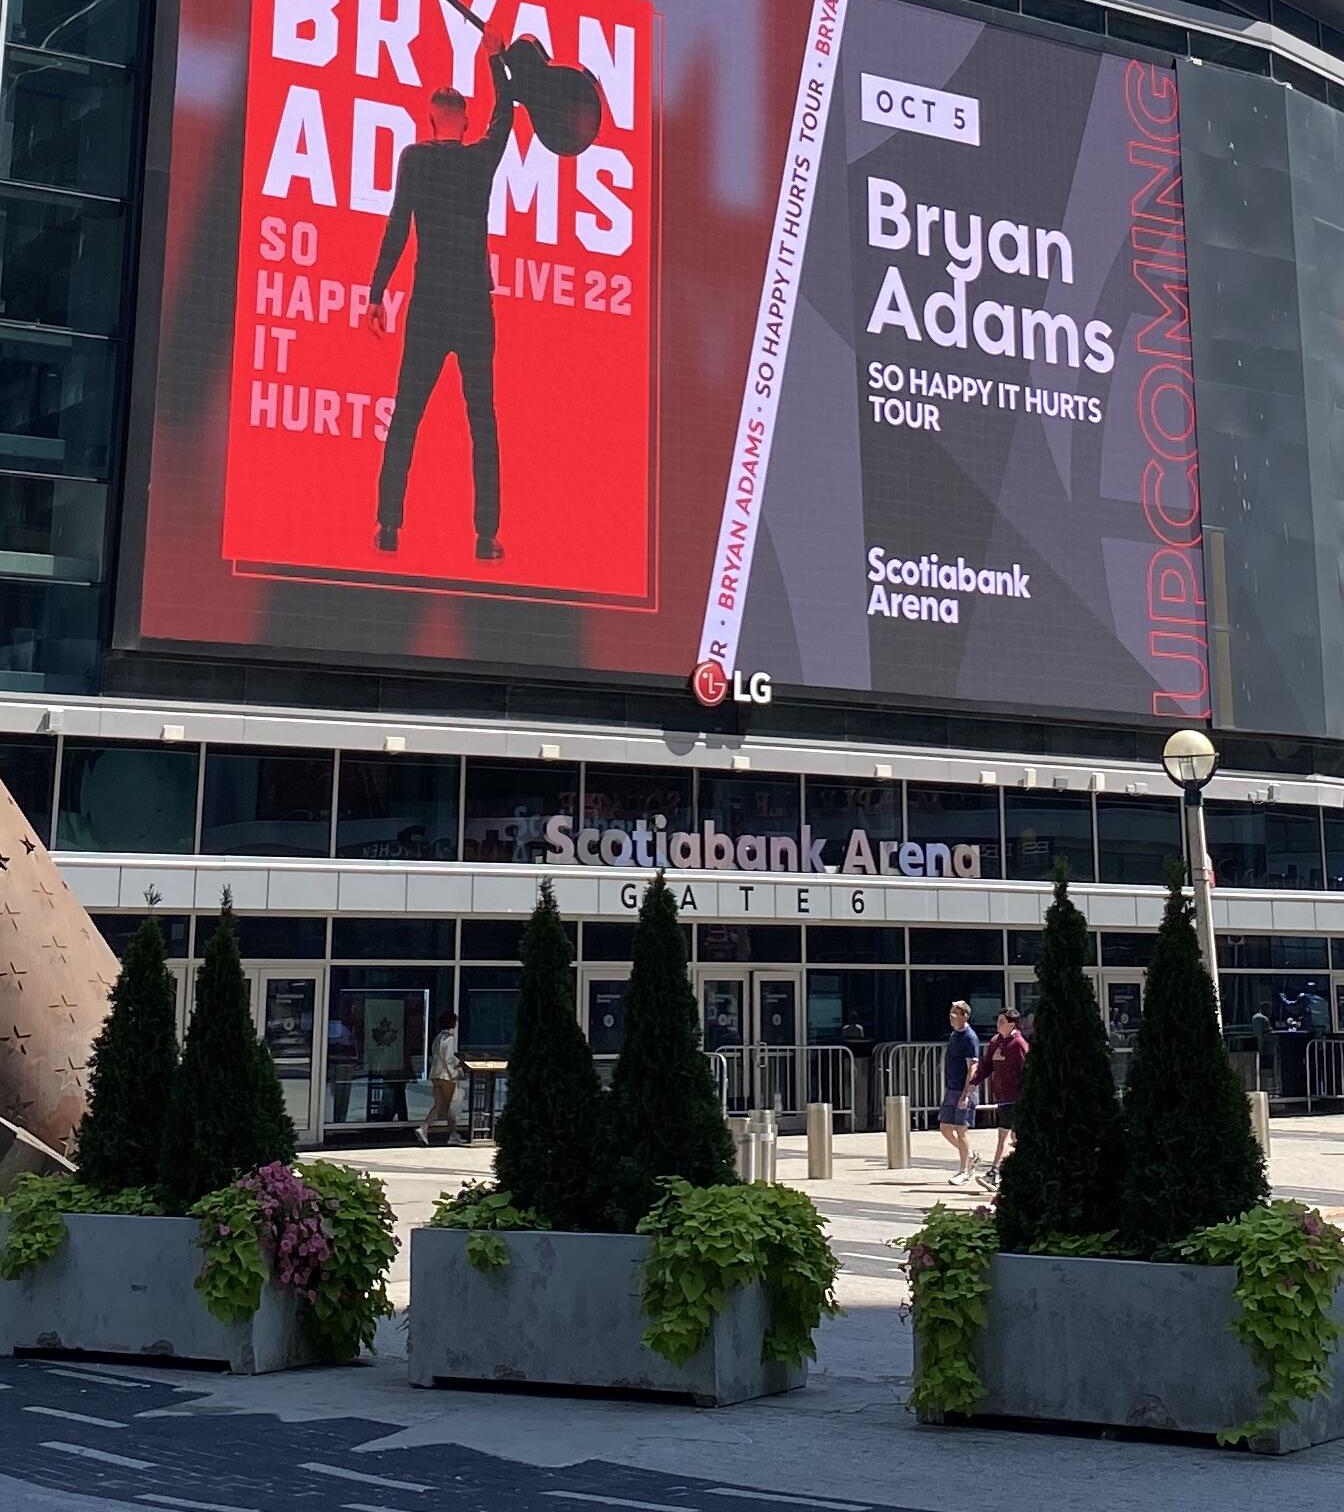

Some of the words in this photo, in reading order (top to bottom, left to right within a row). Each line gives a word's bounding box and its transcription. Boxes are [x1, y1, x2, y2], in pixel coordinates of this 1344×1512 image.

[799, 78, 825, 143] TOUR
[876, 89, 937, 123] OCT
[953, 107, 966, 130] 5
[261, 83, 634, 257] ADMS
[782, 154, 811, 239] HURTS
[259, 219, 319, 267] SO
[777, 239, 796, 267] IT
[866, 175, 1074, 285] Bryan
[256, 269, 406, 334] HAPPY
[490, 253, 576, 307] LIVE
[584, 269, 633, 317] 22
[761, 268, 790, 357] HAPPY
[253, 324, 297, 374] IT
[866, 265, 1116, 374] Adams
[250, 379, 397, 443] HURTS
[755, 362, 775, 399] SO
[868, 361, 905, 392] SO
[908, 367, 994, 406] HAPPY
[997, 381, 1021, 411] IT
[1024, 386, 1103, 424] HURTS
[1123, 58, 1212, 720] UPCOMING
[868, 395, 942, 432] TOUR
[734, 417, 765, 517] ADAMS
[717, 519, 749, 611] BRYAN
[867, 546, 1032, 599] Scotiabank
[866, 584, 959, 624] Arena
[733, 669, 772, 704] LG
[544, 814, 828, 874] Scotiabank
[843, 828, 982, 879] Arena
[620, 883, 810, 915] GATE
[851, 890, 866, 915] 6
